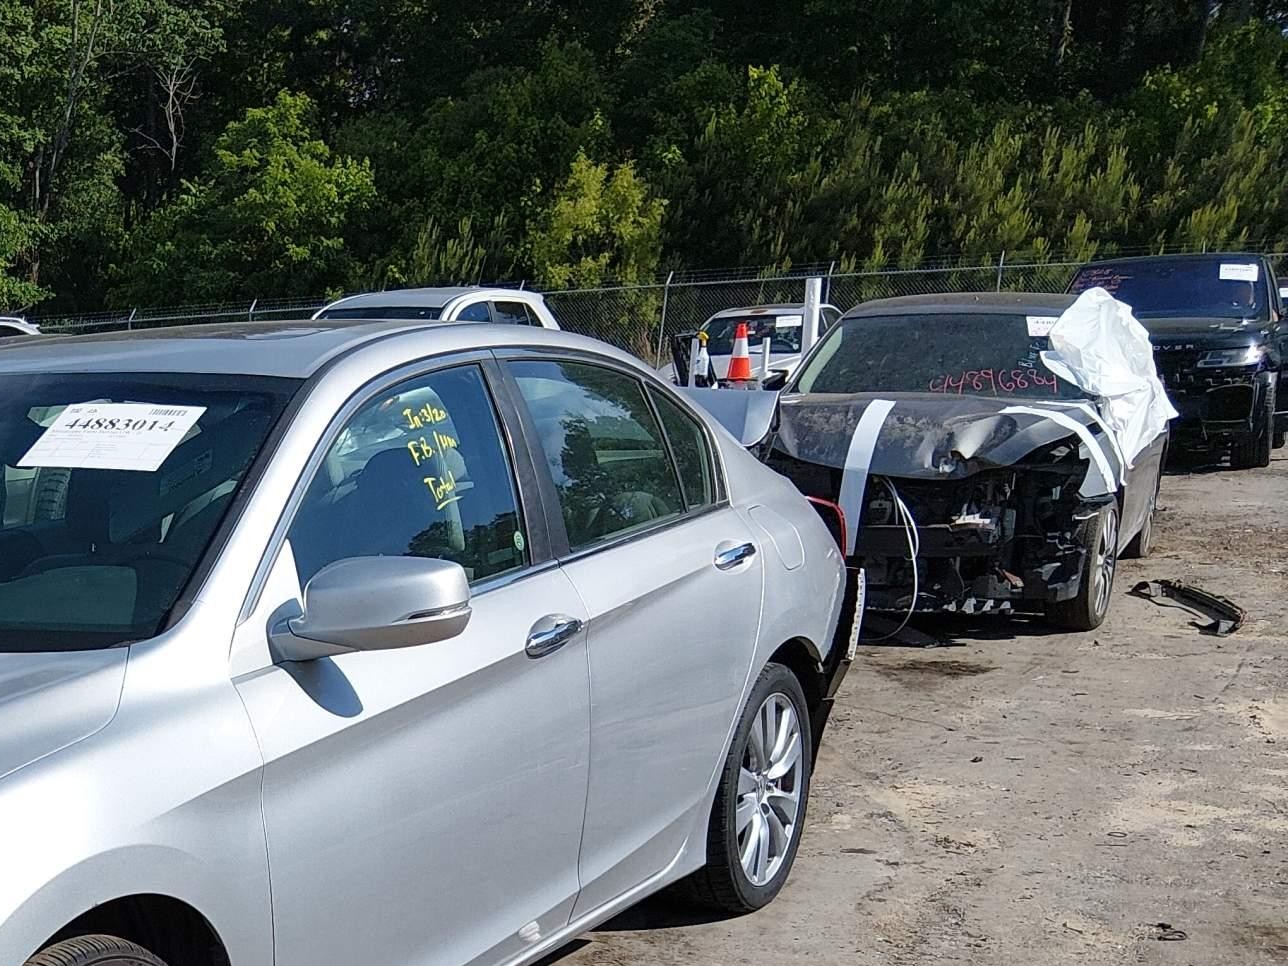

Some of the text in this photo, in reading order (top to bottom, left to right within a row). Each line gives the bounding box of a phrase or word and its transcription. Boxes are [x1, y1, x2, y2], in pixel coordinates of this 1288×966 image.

[930, 368, 1058, 396] 44896884
[65, 418, 175, 432] 44883014
[424, 470, 457, 503] Total
